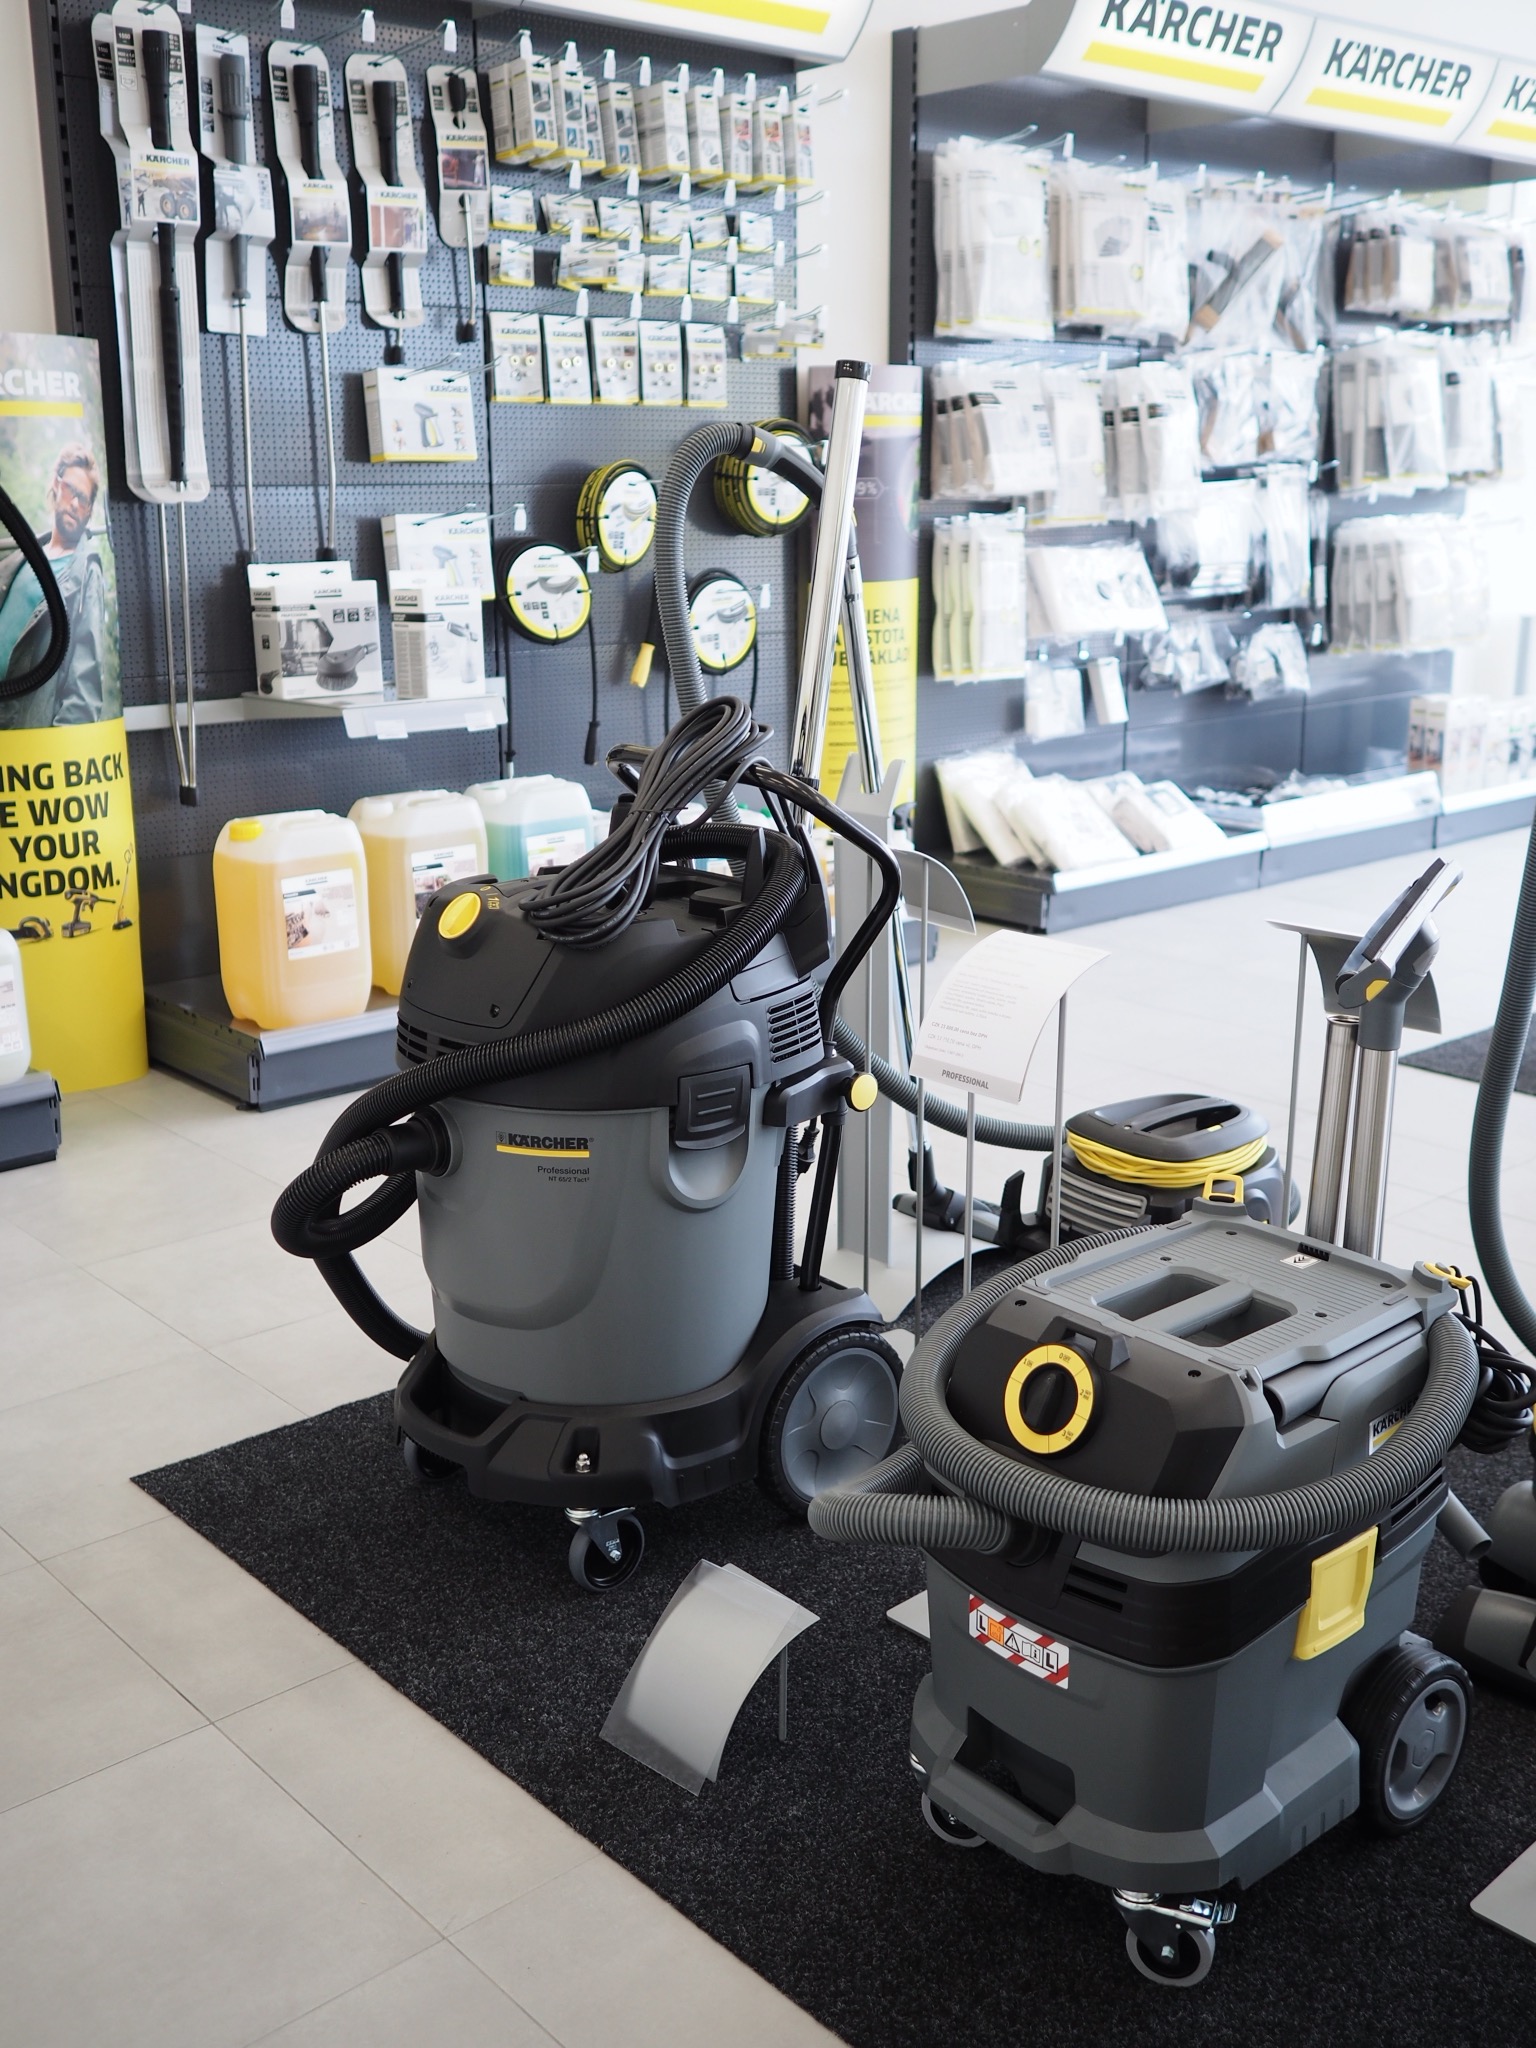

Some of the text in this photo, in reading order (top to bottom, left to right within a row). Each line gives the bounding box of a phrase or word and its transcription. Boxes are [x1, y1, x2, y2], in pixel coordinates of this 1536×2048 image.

[1323, 37, 1472, 100] KÄRCHER
[63, 752, 124, 788] BACK
[27, 791, 109, 827] WOW
[8, 829, 101, 863] YOUR
[941, 1069, 989, 1090] PROFESSIONAL
[508, 1132, 589, 1150] KÄRCHER
[537, 1165, 590, 1175] Professional
[979, 1614, 986, 1631] L
[1045, 1652, 1055, 1669] L
